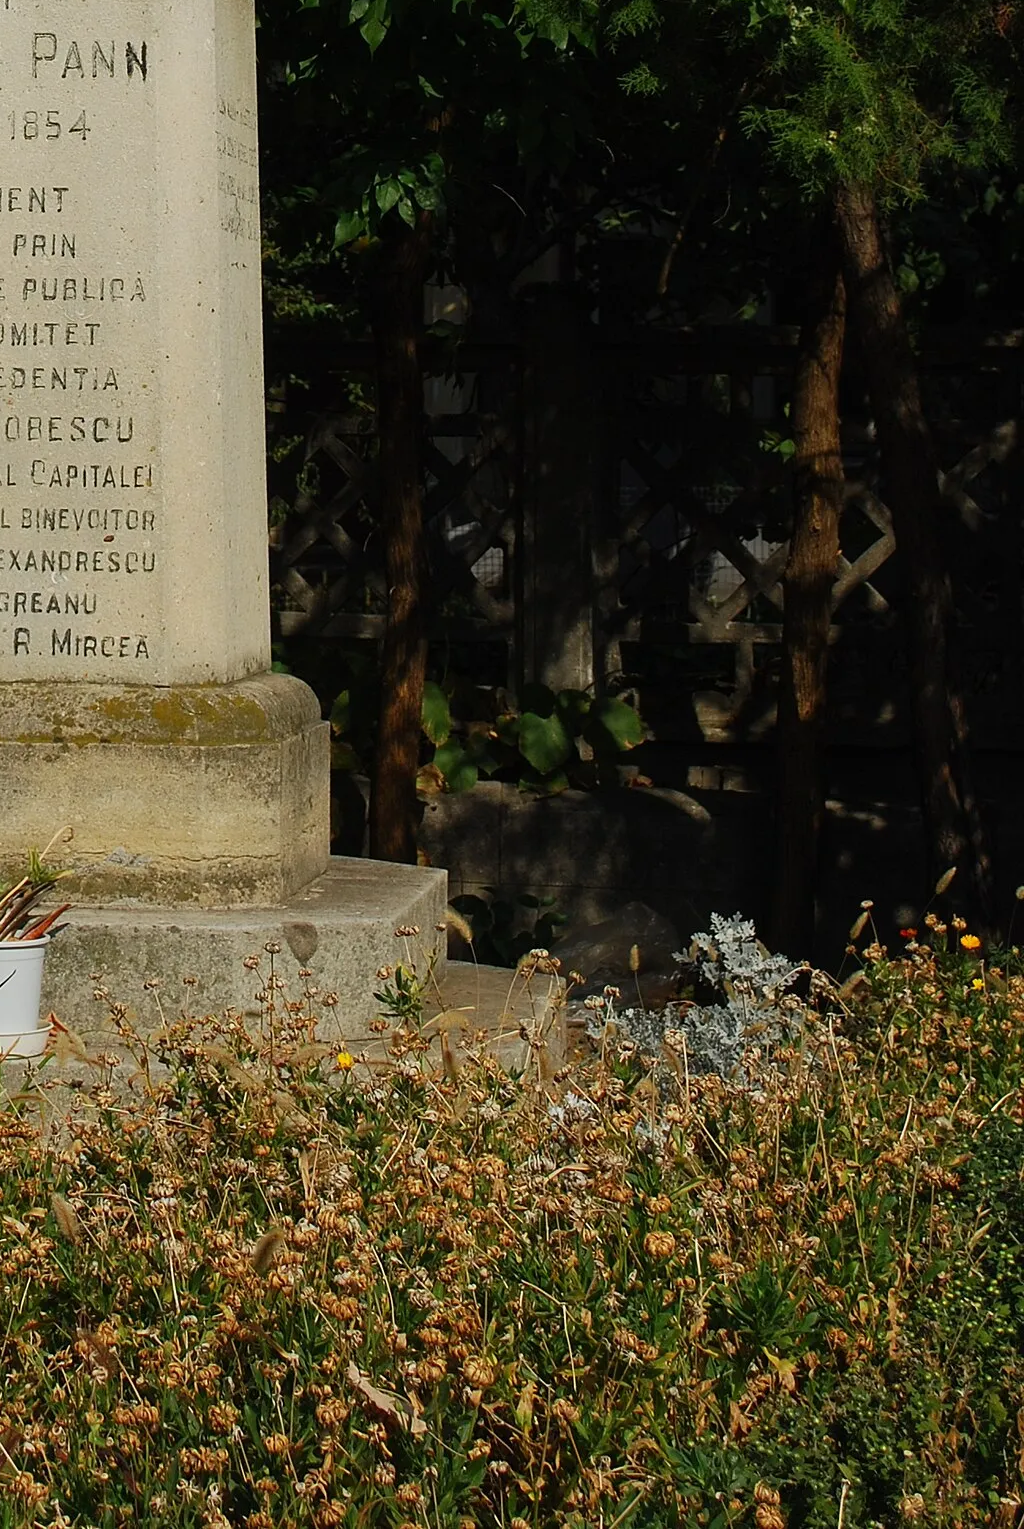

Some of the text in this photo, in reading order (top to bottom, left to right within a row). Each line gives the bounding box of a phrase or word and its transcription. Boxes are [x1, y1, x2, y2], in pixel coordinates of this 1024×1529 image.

[32, 32, 148, 82] PANN
[7, 109, 92, 142] 1854
[13, 233, 77, 260] PRIN
[30, 460, 153, 490] CAPITALEI
[21, 507, 156, 532] BINEVOITOR
